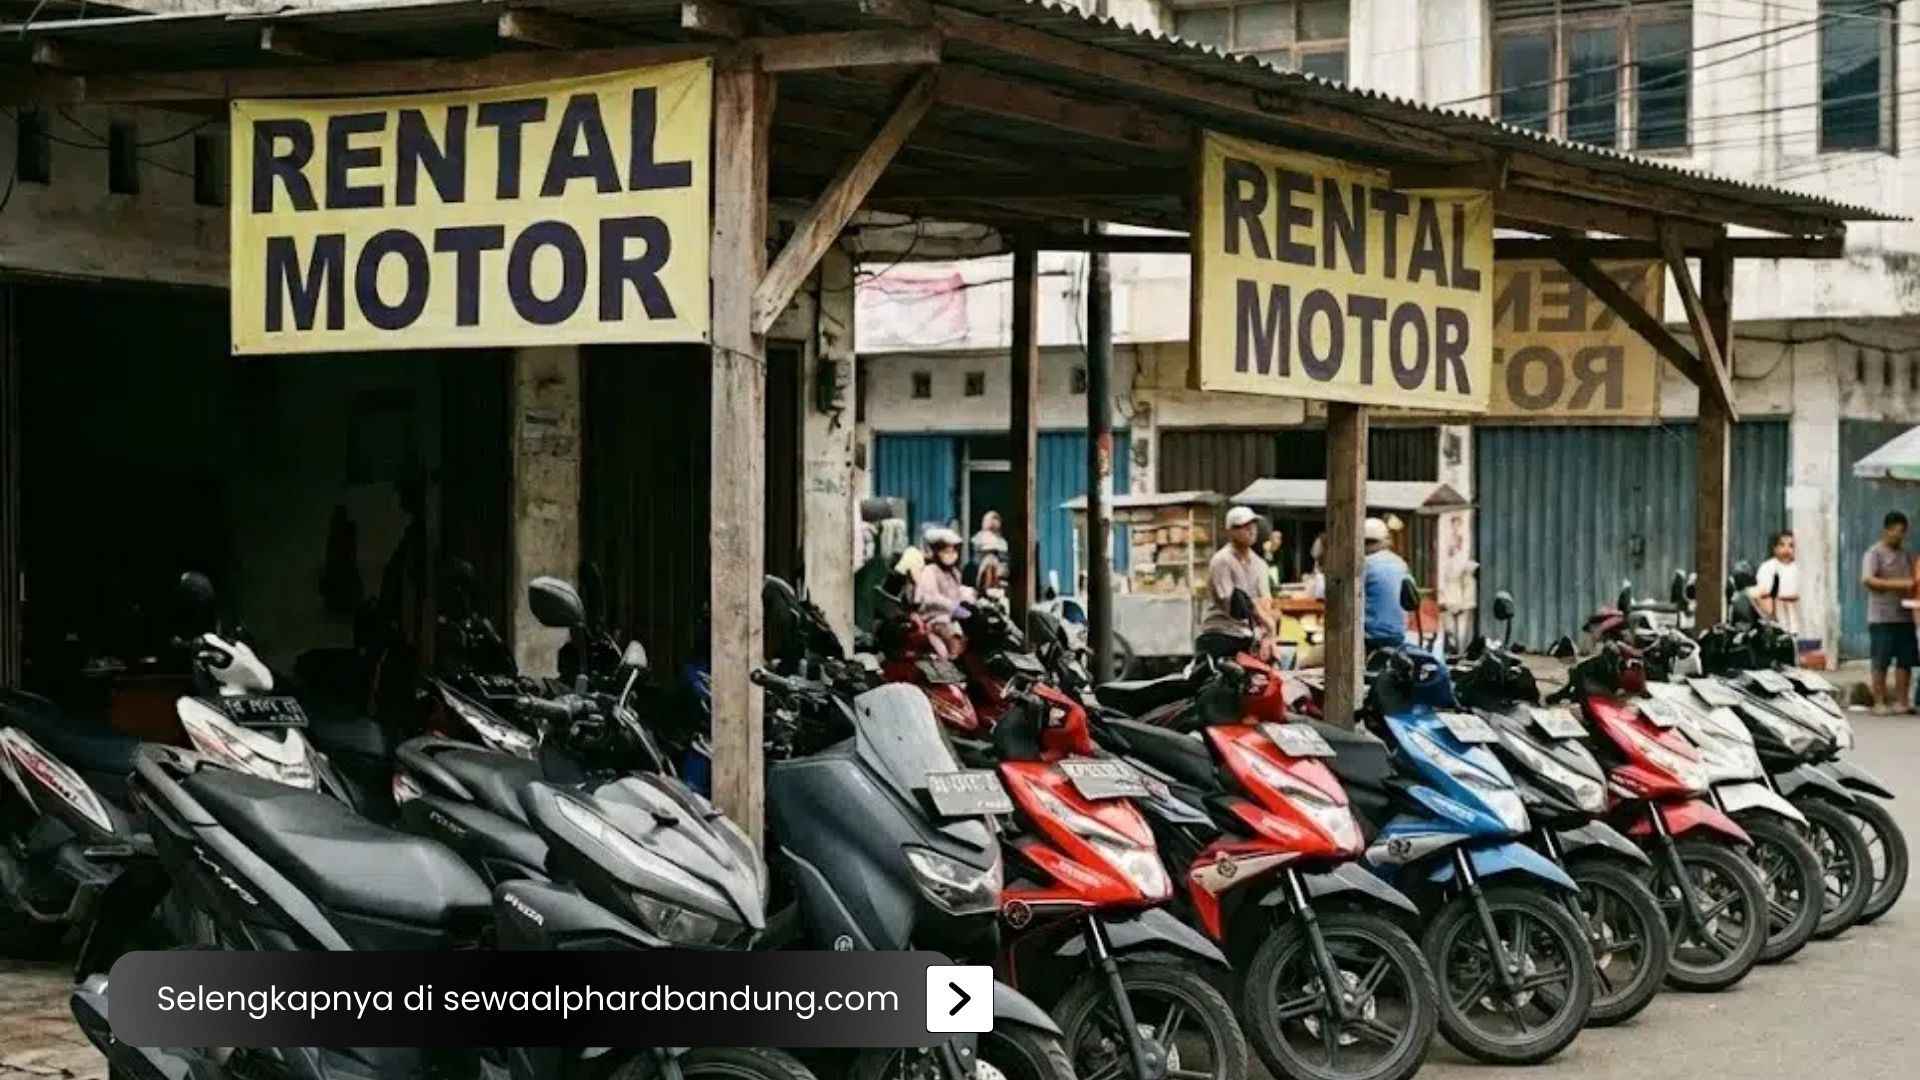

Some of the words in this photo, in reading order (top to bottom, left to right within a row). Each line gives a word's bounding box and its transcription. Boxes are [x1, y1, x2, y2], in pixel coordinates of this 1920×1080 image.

[251, 86, 692, 214] RENTAL
[264, 215, 677, 333] MOTOR
[1222, 157, 1482, 292] RENTAL
[1235, 279, 1471, 395] MOTOR
